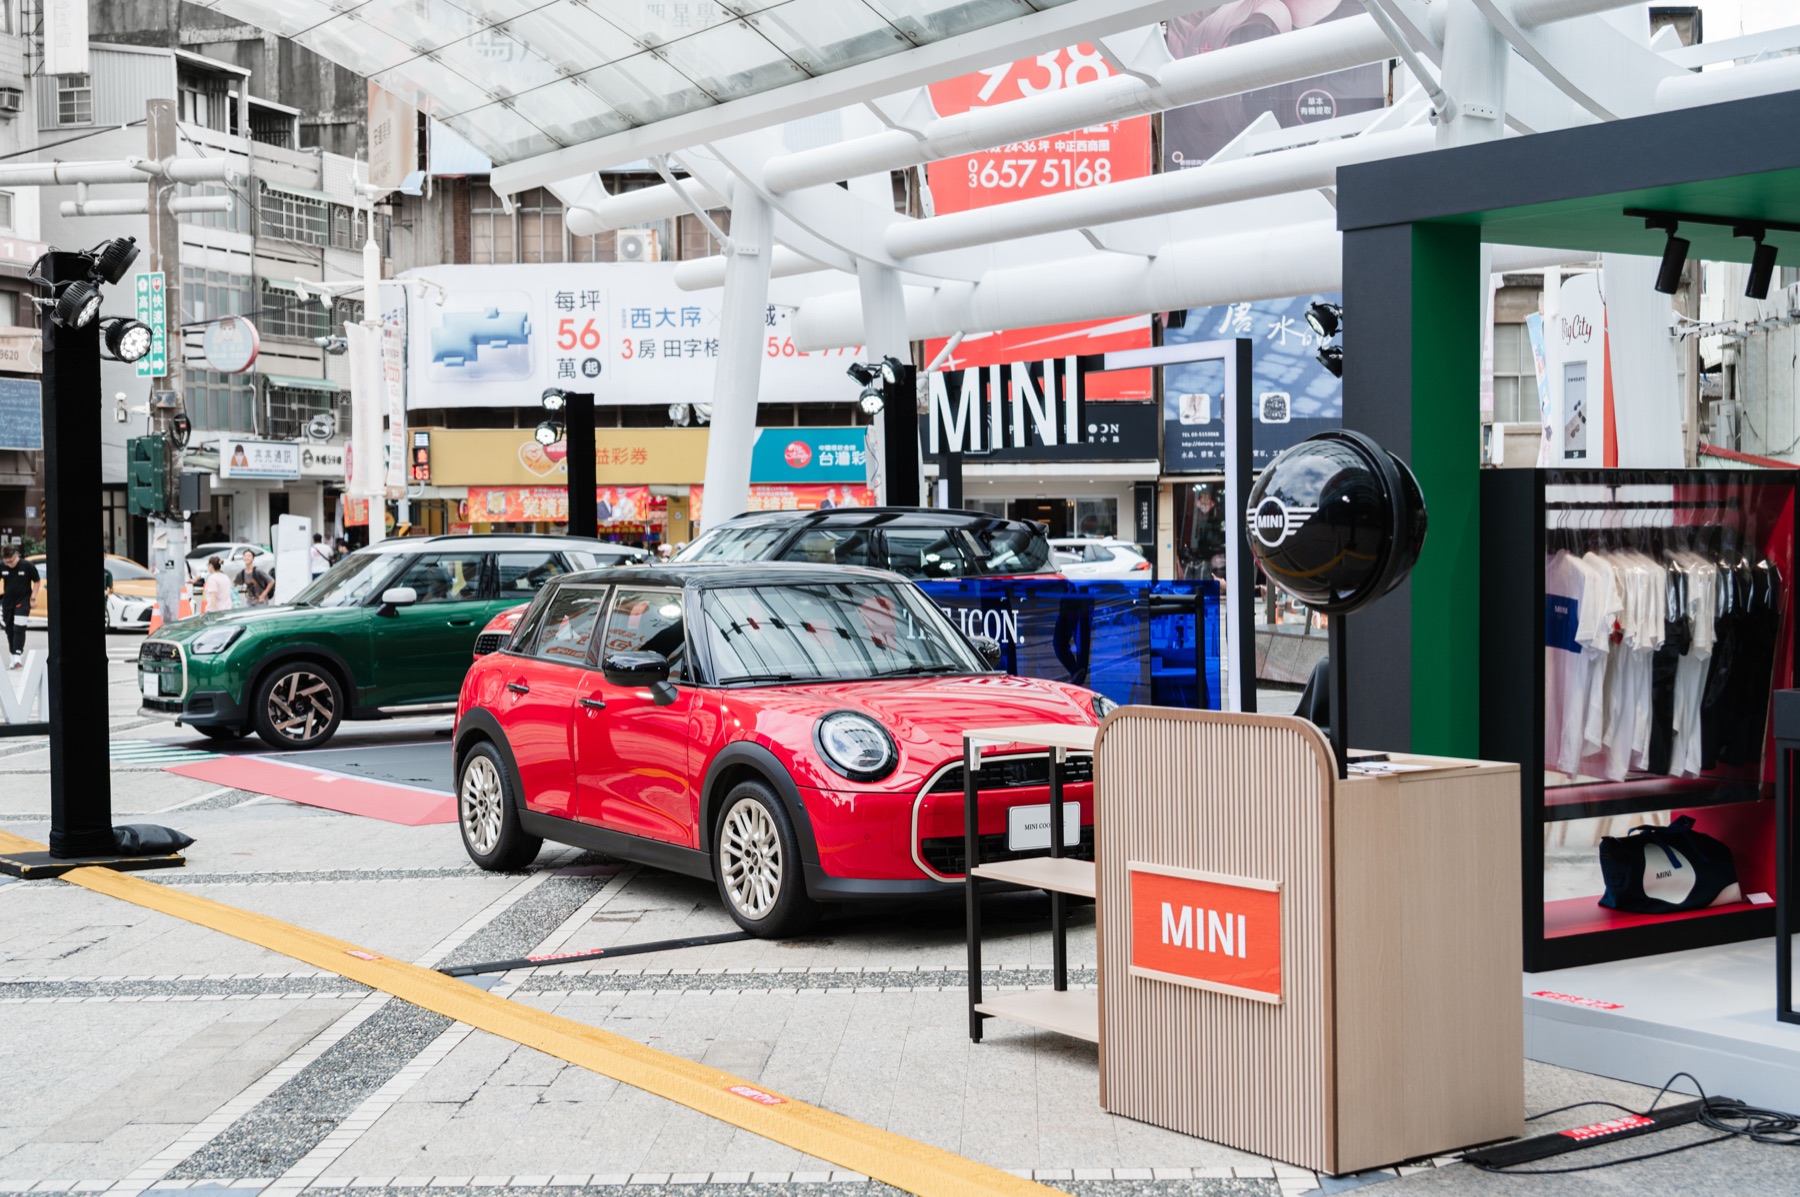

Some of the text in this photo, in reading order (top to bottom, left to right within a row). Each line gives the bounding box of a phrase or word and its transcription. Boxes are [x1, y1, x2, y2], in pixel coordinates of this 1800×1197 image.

[554, 290, 601, 312] 每坪
[152, 294, 164, 354] 快速公路
[631, 307, 701, 329] 西大序
[557, 318, 601, 350] 56
[621, 338, 634, 360] 3
[767, 336, 810, 357] 56
[928, 354, 1079, 454] MINI
[1258, 515, 1283, 528] MINI
[958, 608, 1025, 644] ICON.
[1024, 823, 1038, 831] MINI
[1656, 870, 1672, 880] MINI
[1161, 902, 1246, 959] MINI
